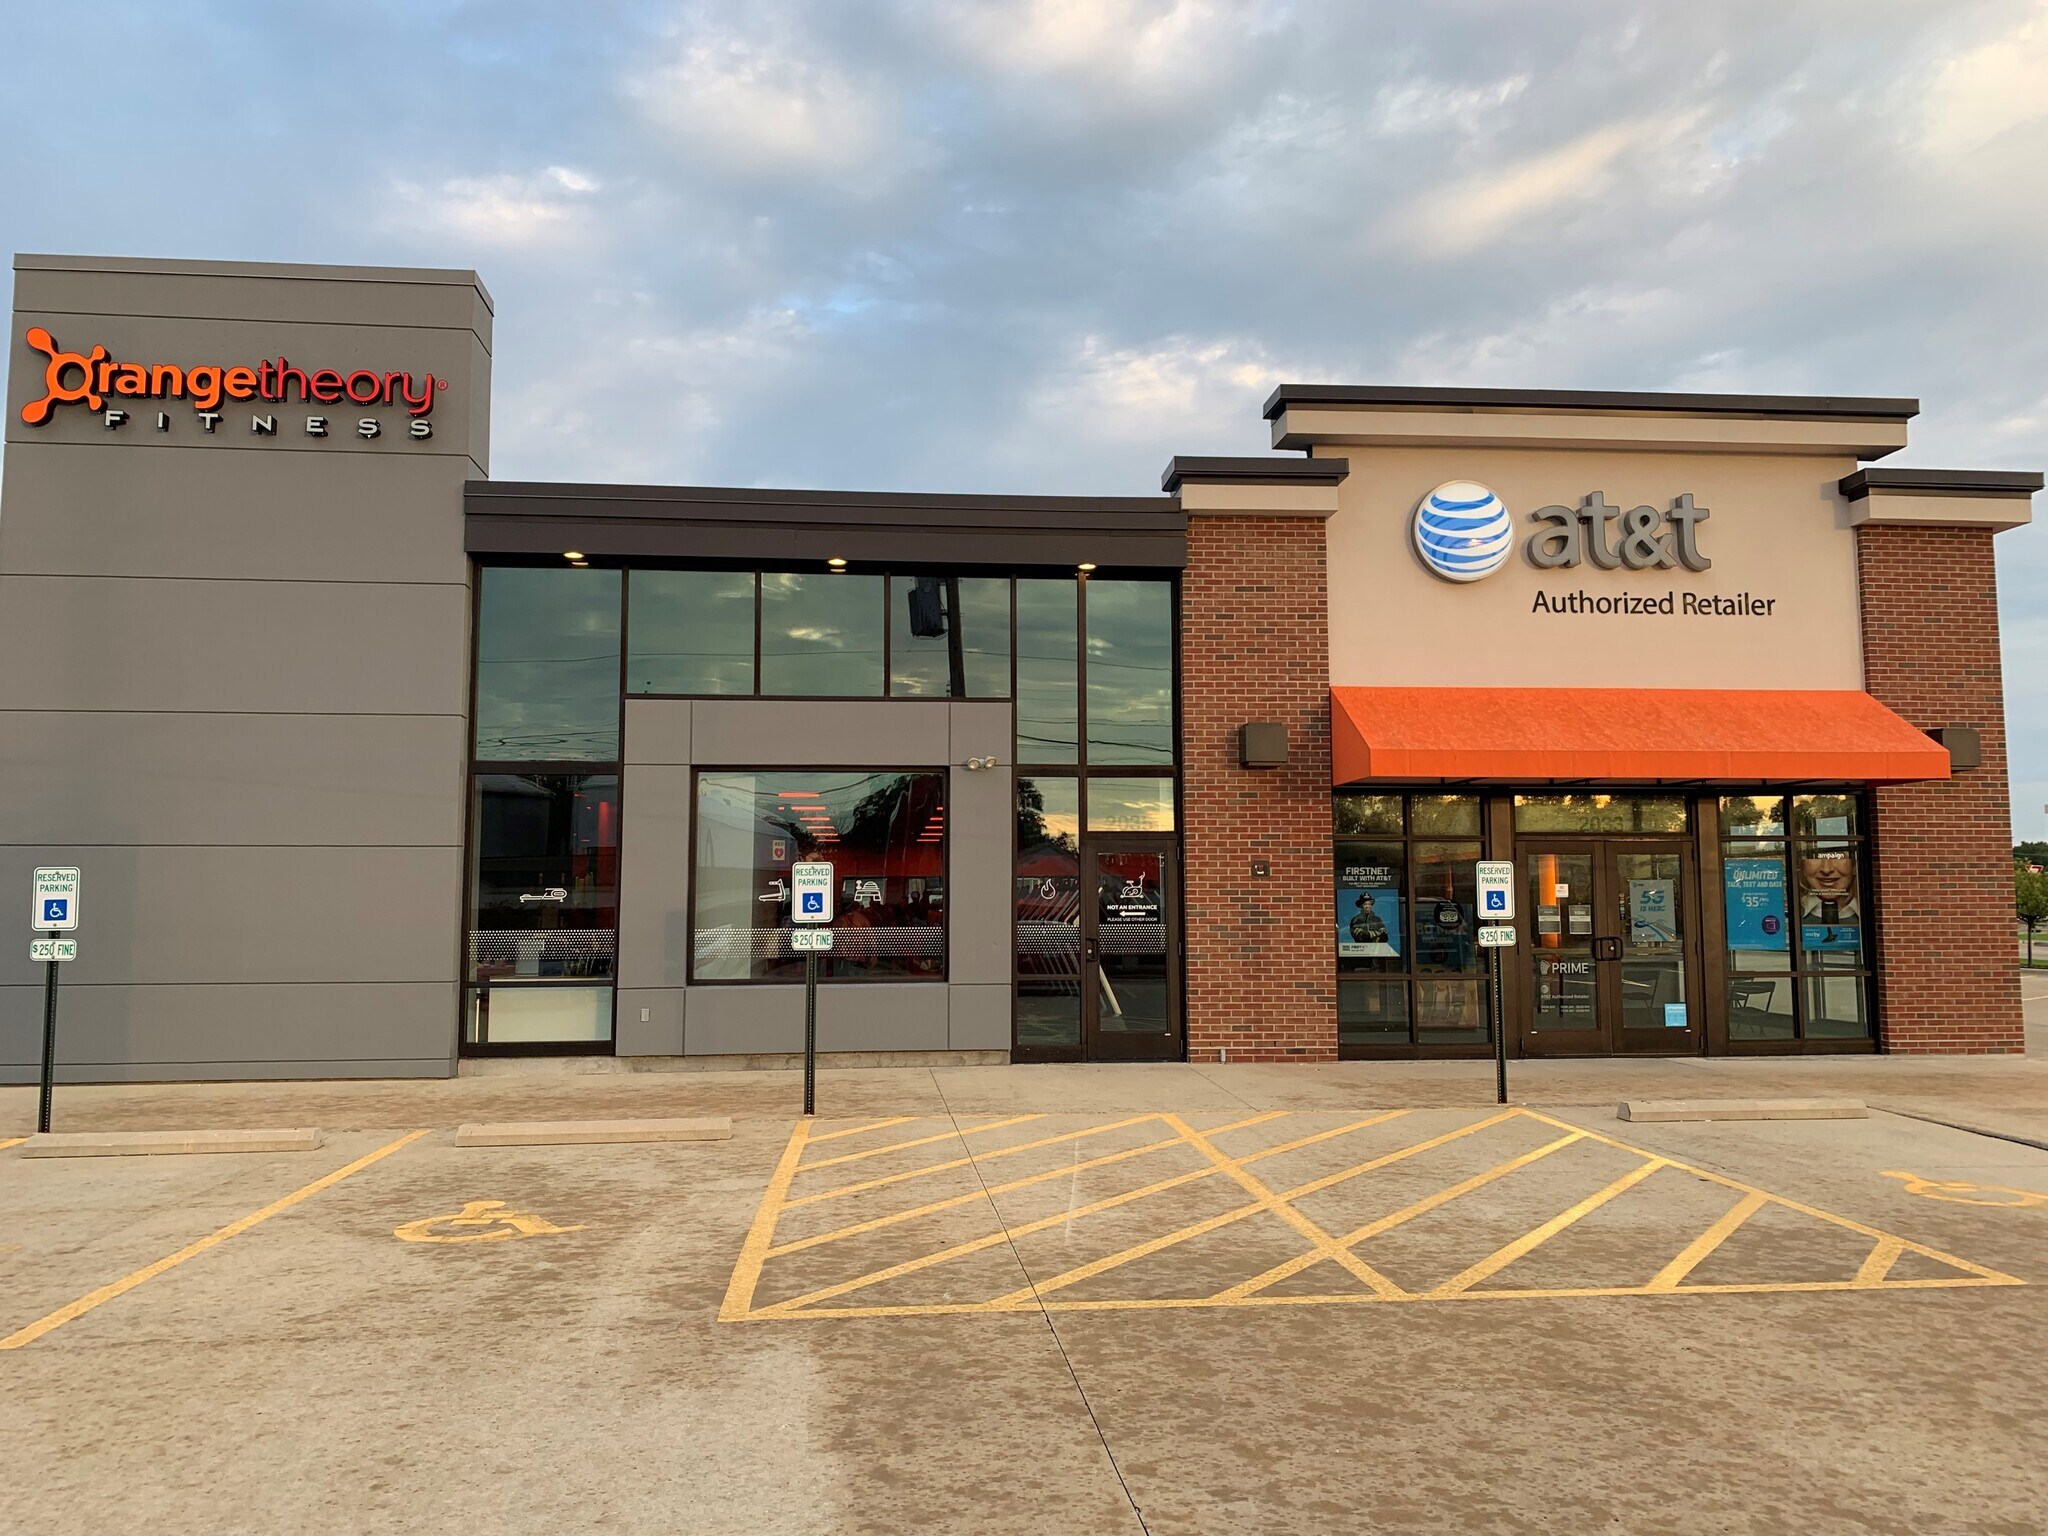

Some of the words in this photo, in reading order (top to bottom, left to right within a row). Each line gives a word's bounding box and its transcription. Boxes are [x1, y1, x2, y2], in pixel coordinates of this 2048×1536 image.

[104, 409, 434, 440] FITNESS
[1527, 490, 1712, 572] at&t
[1532, 590, 1674, 615] Authorized
[1682, 592, 1775, 616] Retailer
[796, 868, 830, 876] RESERVED
[1346, 867, 1388, 875] FIRSTNET
[1733, 870, 1778, 880] UNLIMITED
[38, 874, 76, 882] RESERVED
[798, 878, 828, 886] PARKING
[40, 884, 73, 892] PARKING
[1640, 890, 1664, 904] 5G
[816, 934, 831, 946] FINE
[1500, 930, 1514, 942] FINE
[58, 944, 74, 956] FINE
[1552, 962, 1588, 974] PRIME
